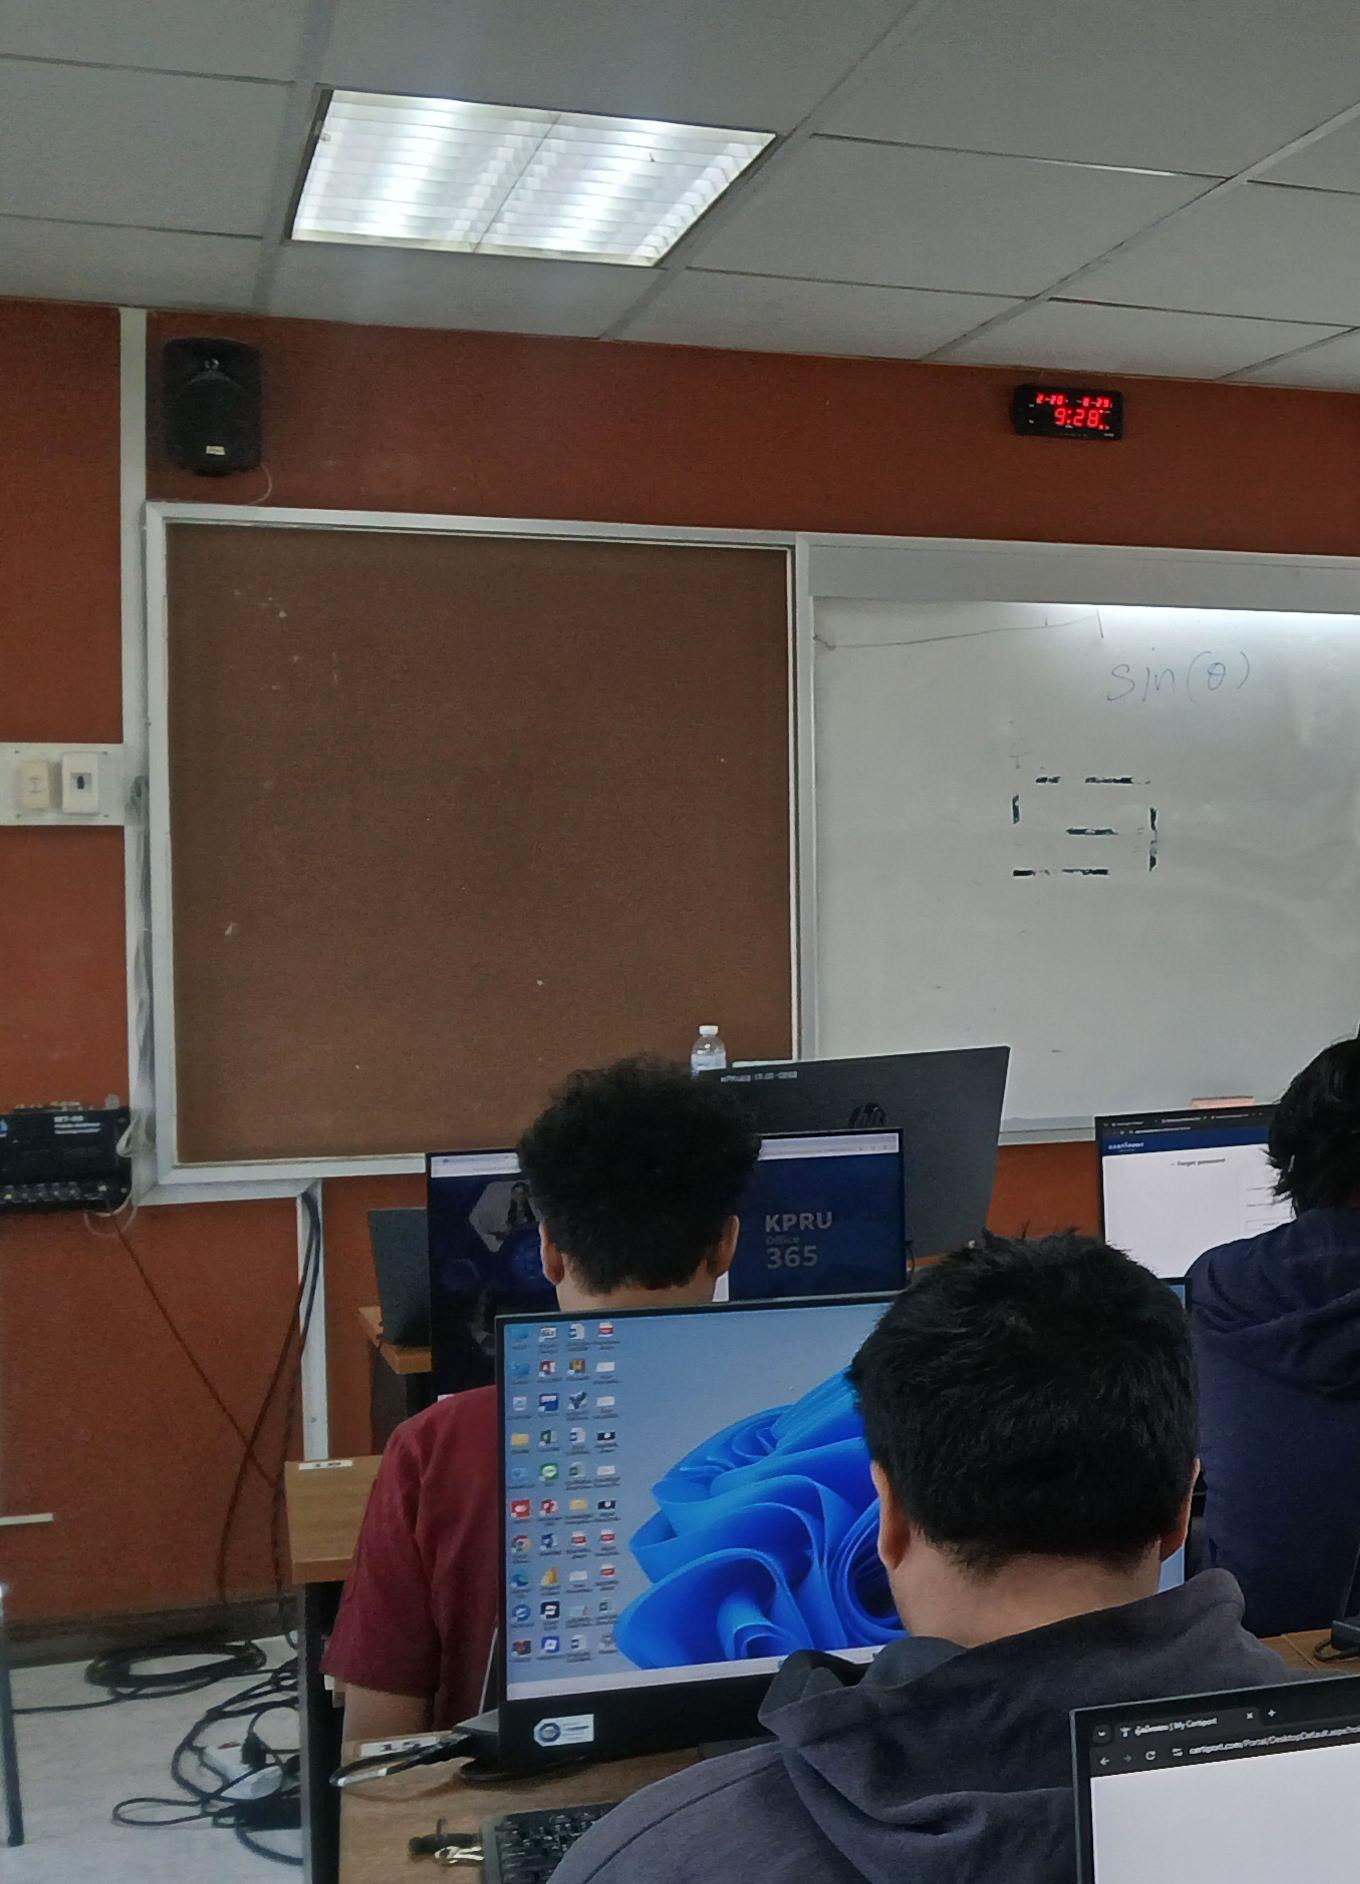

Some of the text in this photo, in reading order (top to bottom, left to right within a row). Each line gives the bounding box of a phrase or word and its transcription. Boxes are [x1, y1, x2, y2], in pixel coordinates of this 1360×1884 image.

[1055, 408, 1099, 428] 9:28
[766, 1211, 833, 1232] KPRU
[767, 1245, 818, 1269] 365
